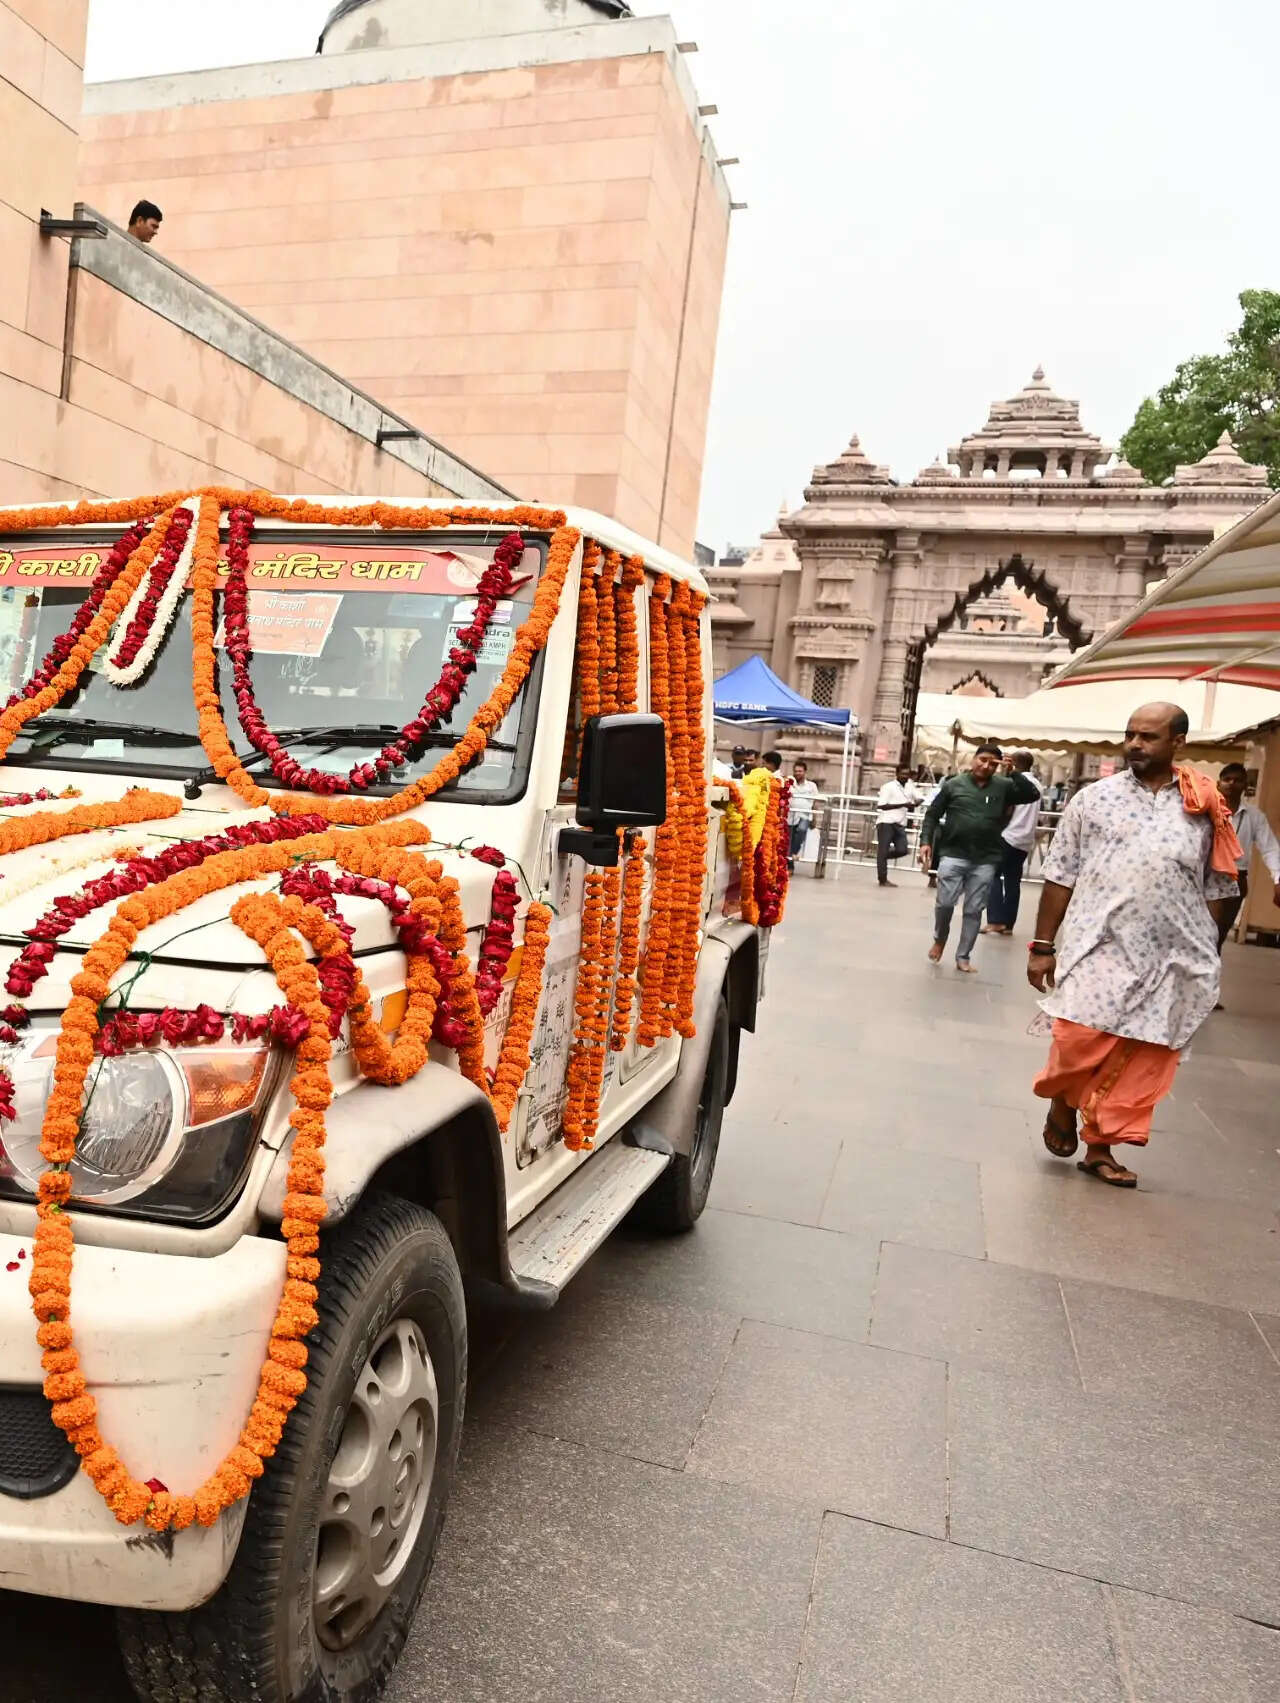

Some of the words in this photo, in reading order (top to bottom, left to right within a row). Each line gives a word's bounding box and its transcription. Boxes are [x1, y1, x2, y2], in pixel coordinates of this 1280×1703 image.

[17, 553, 102, 577] काशी
[252, 553, 346, 579] मंदिर
[350, 560, 428, 581] धाम
[715, 701, 740, 710] HDFC
[741, 703, 768, 712] BANK
